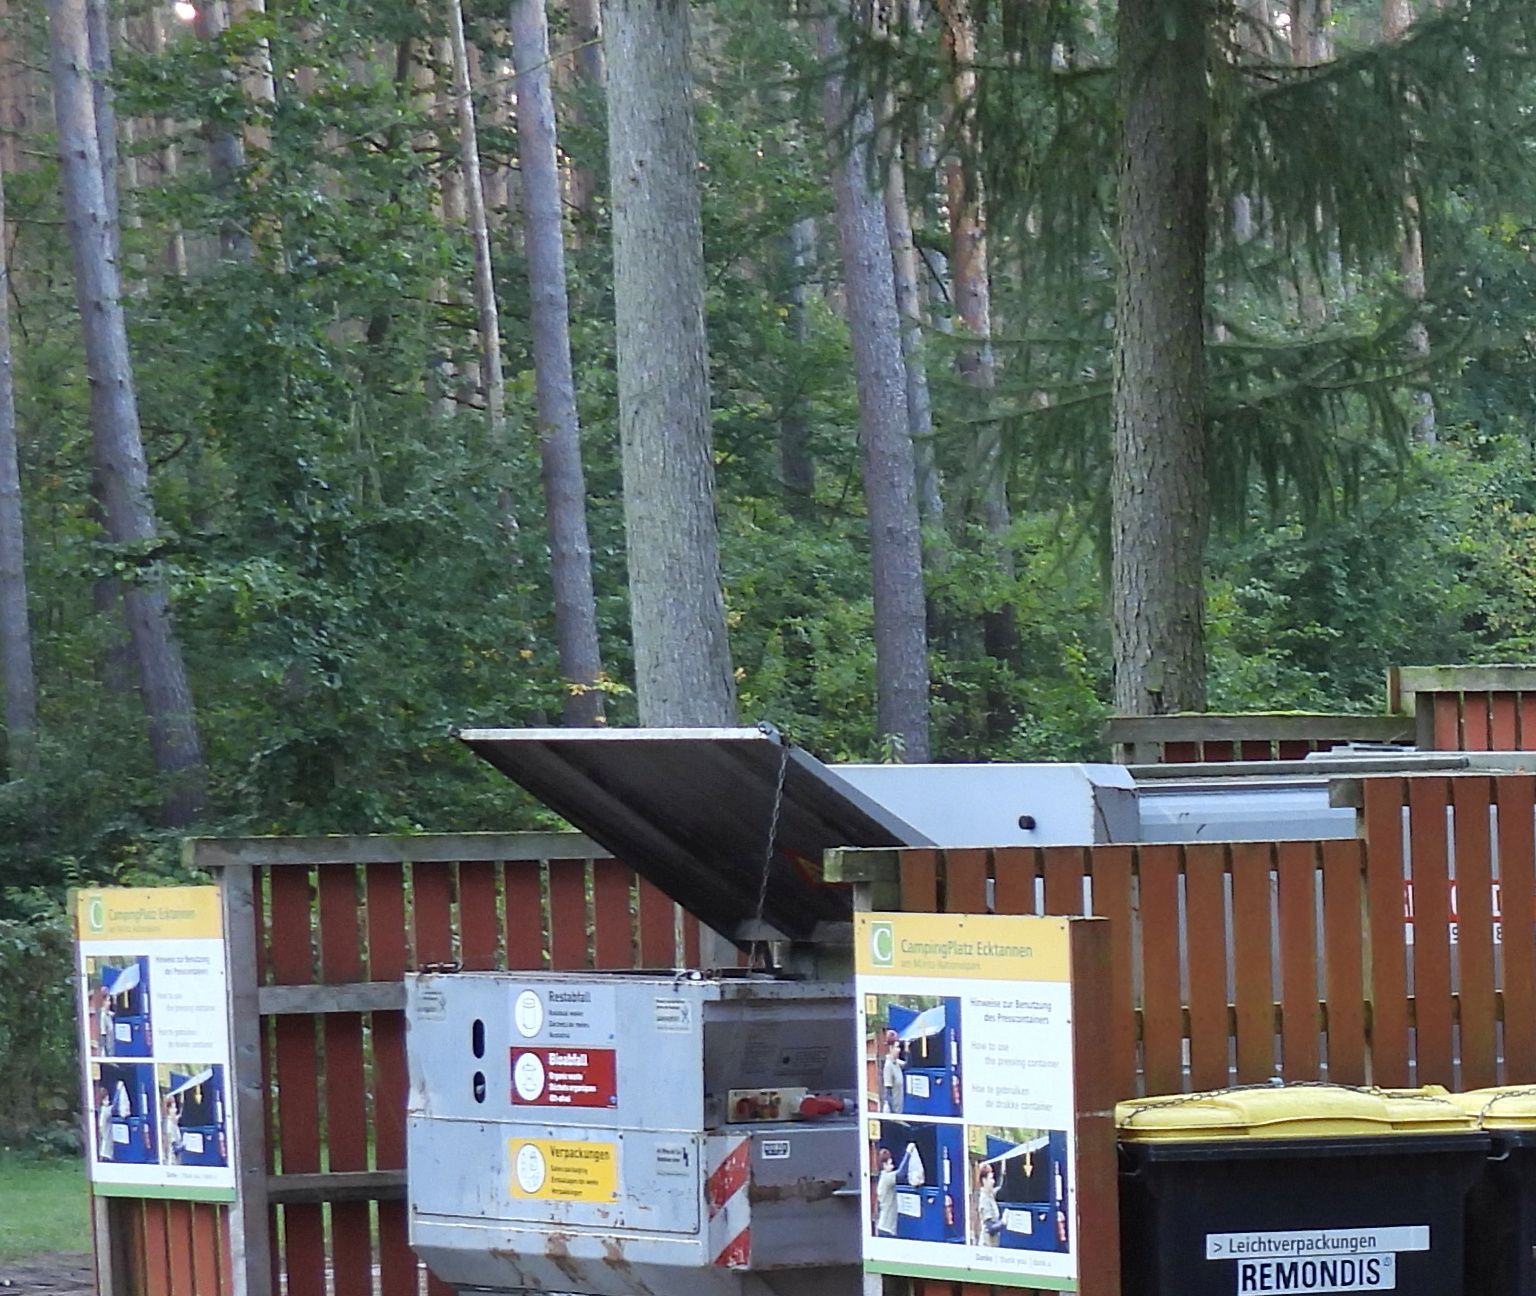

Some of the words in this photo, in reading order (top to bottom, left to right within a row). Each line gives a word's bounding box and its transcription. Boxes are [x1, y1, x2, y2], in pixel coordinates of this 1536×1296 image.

[873, 927, 892, 961] C
[901, 939, 973, 959] CampingPlatz
[977, 941, 1033, 958] Ecktannen
[549, 991, 592, 1002] Restabfall
[550, 1146, 610, 1162] Verpackungen
[1229, 1234, 1377, 1254] Leichtverpackungen
